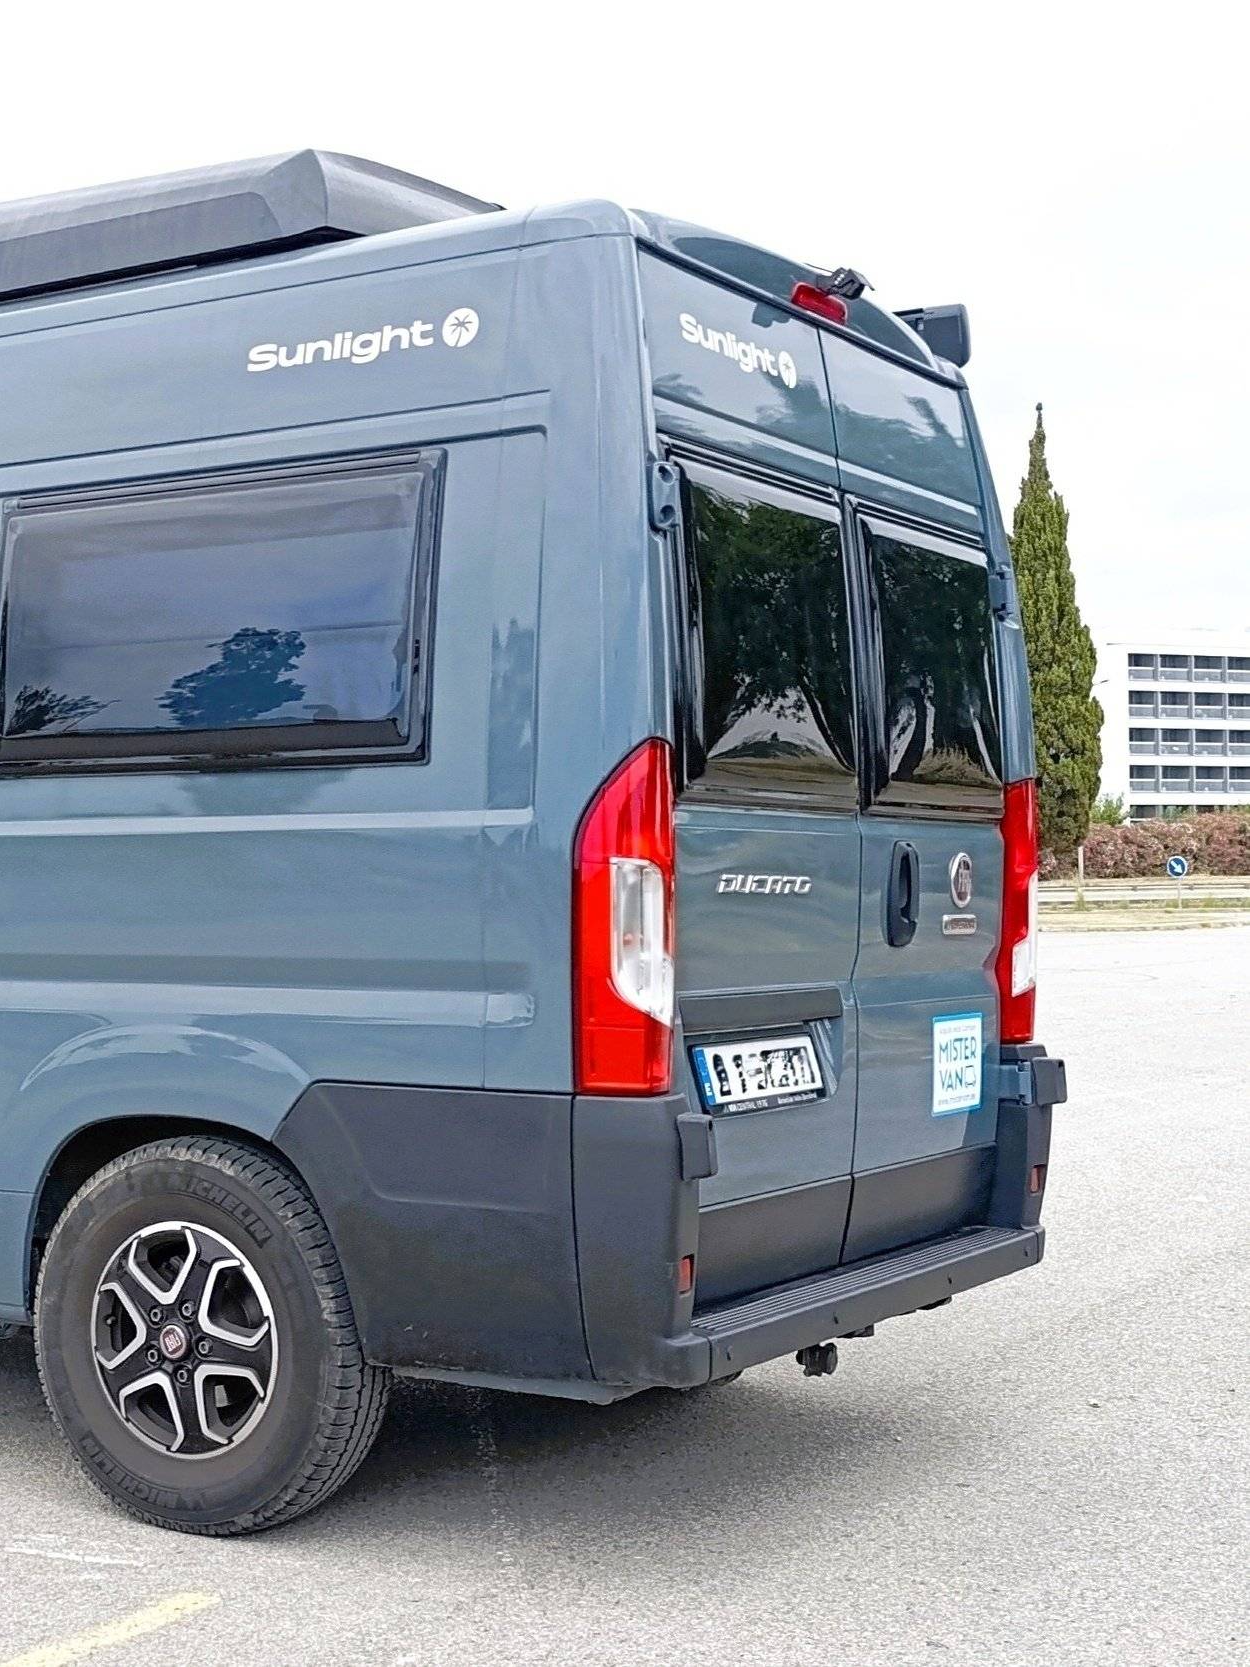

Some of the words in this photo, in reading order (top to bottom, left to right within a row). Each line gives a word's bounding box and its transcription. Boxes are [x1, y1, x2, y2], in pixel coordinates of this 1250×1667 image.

[247, 320, 434, 372] Sunlight
[679, 312, 778, 376] Sunlight
[717, 873, 812, 894] DUCATO
[939, 1036, 977, 1065] MISTER
[939, 1066, 964, 1092] VAN
